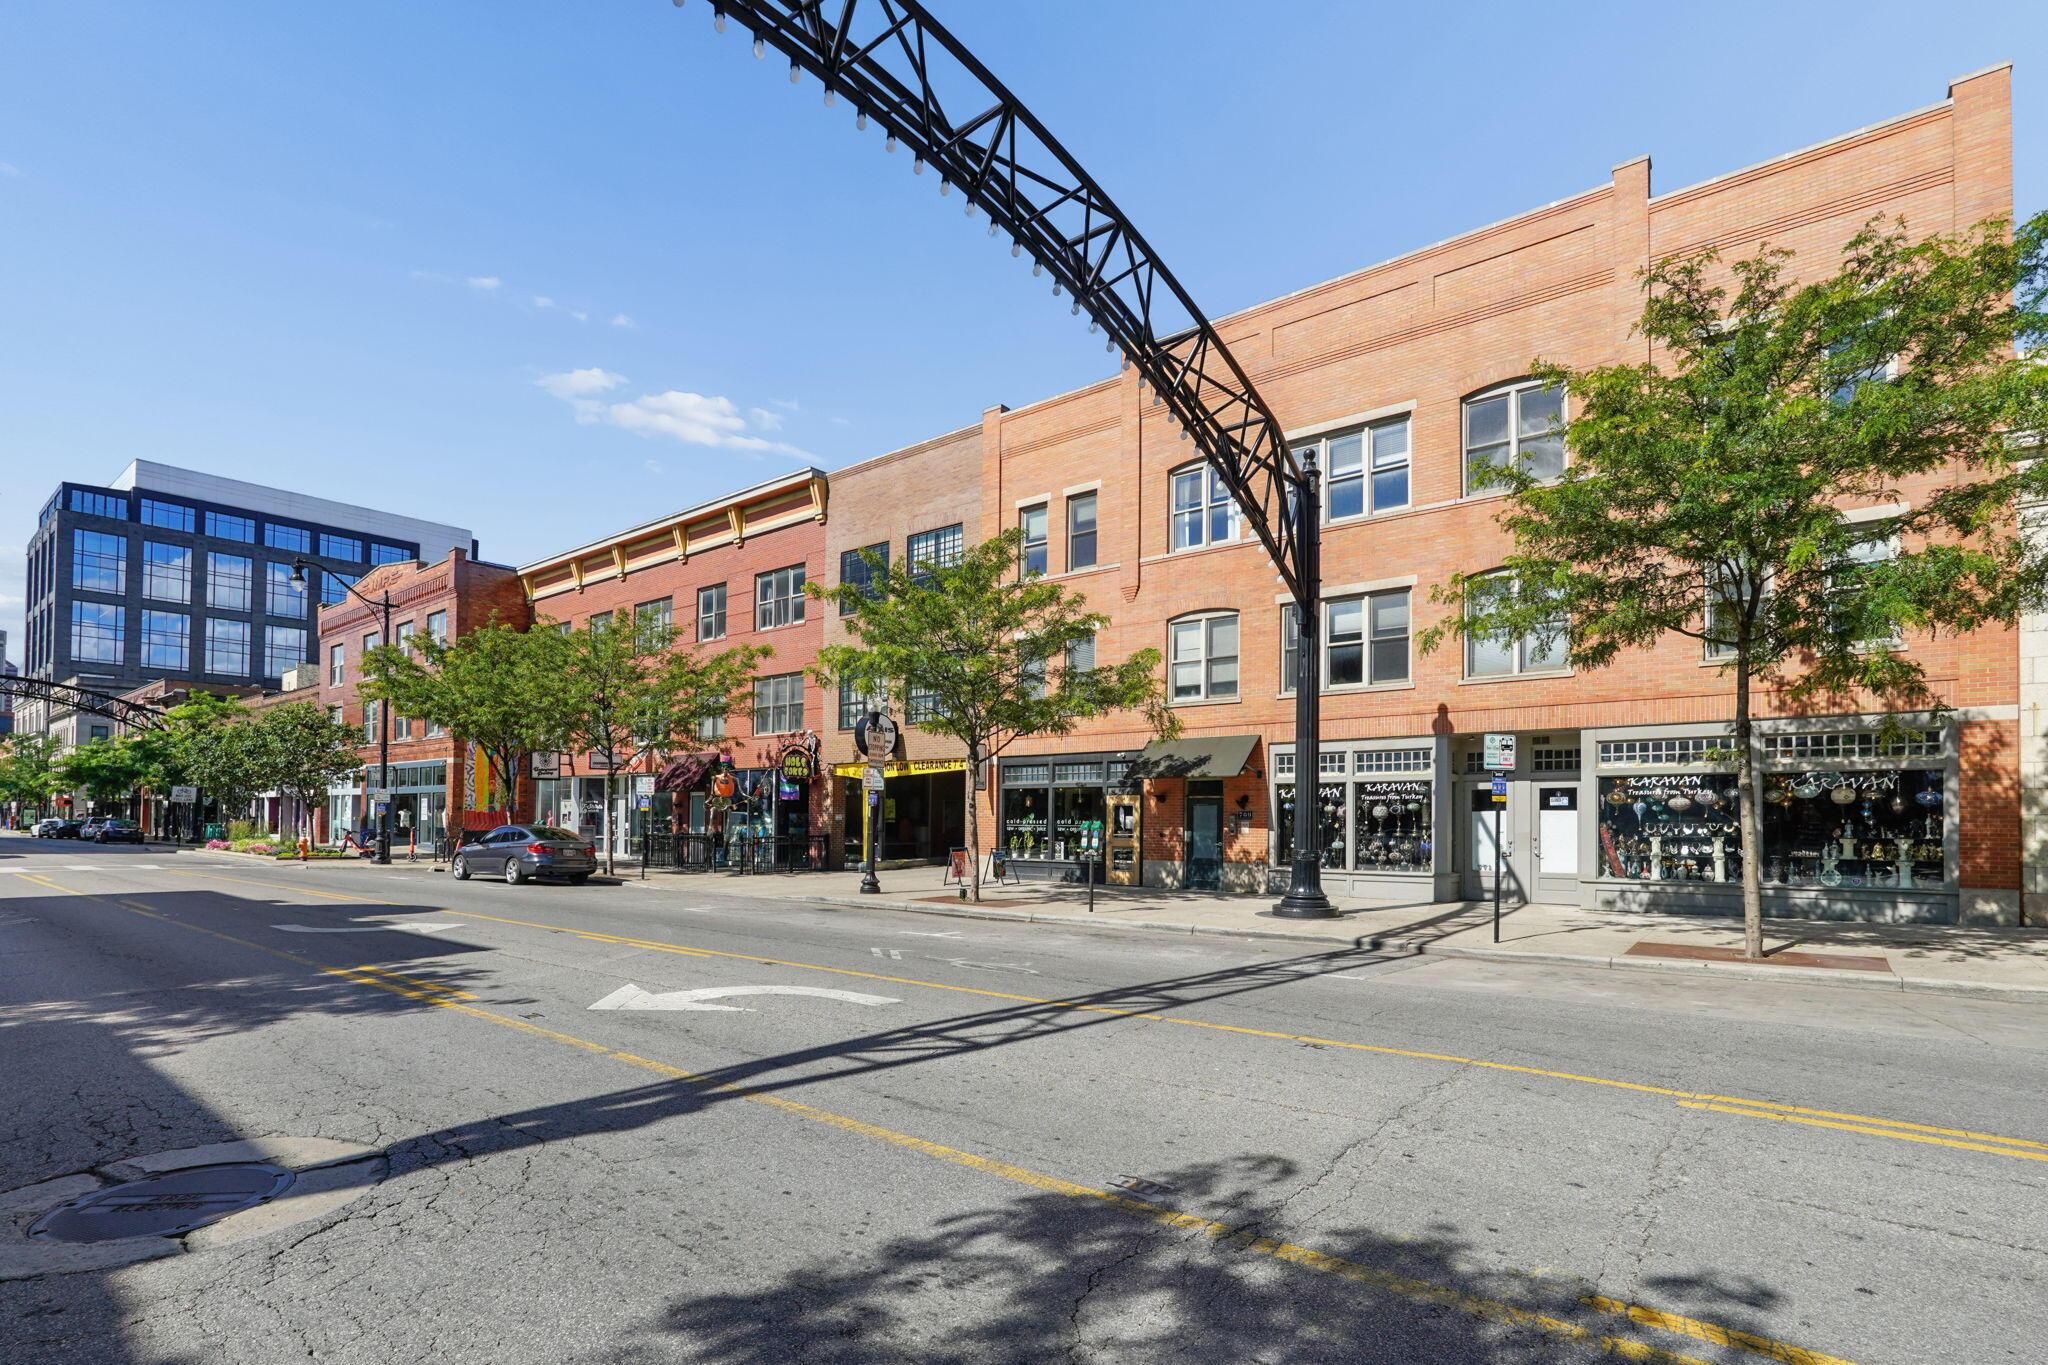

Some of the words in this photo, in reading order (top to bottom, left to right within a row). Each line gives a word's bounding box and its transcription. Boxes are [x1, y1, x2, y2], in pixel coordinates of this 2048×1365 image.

[896, 762, 909, 772] LOW
[913, 759, 952, 771] CLEARANCE
[1364, 782, 1420, 794] KARAVAN
[1626, 774, 1704, 789] KARAVAN
[1786, 775, 1900, 794] KARAVAN
[1278, 786, 1343, 799] KAAN
[1386, 792, 1400, 803] from
[1401, 793, 1424, 803] Turkey
[1661, 787, 1681, 799] from
[1681, 787, 1713, 799] Turkey
